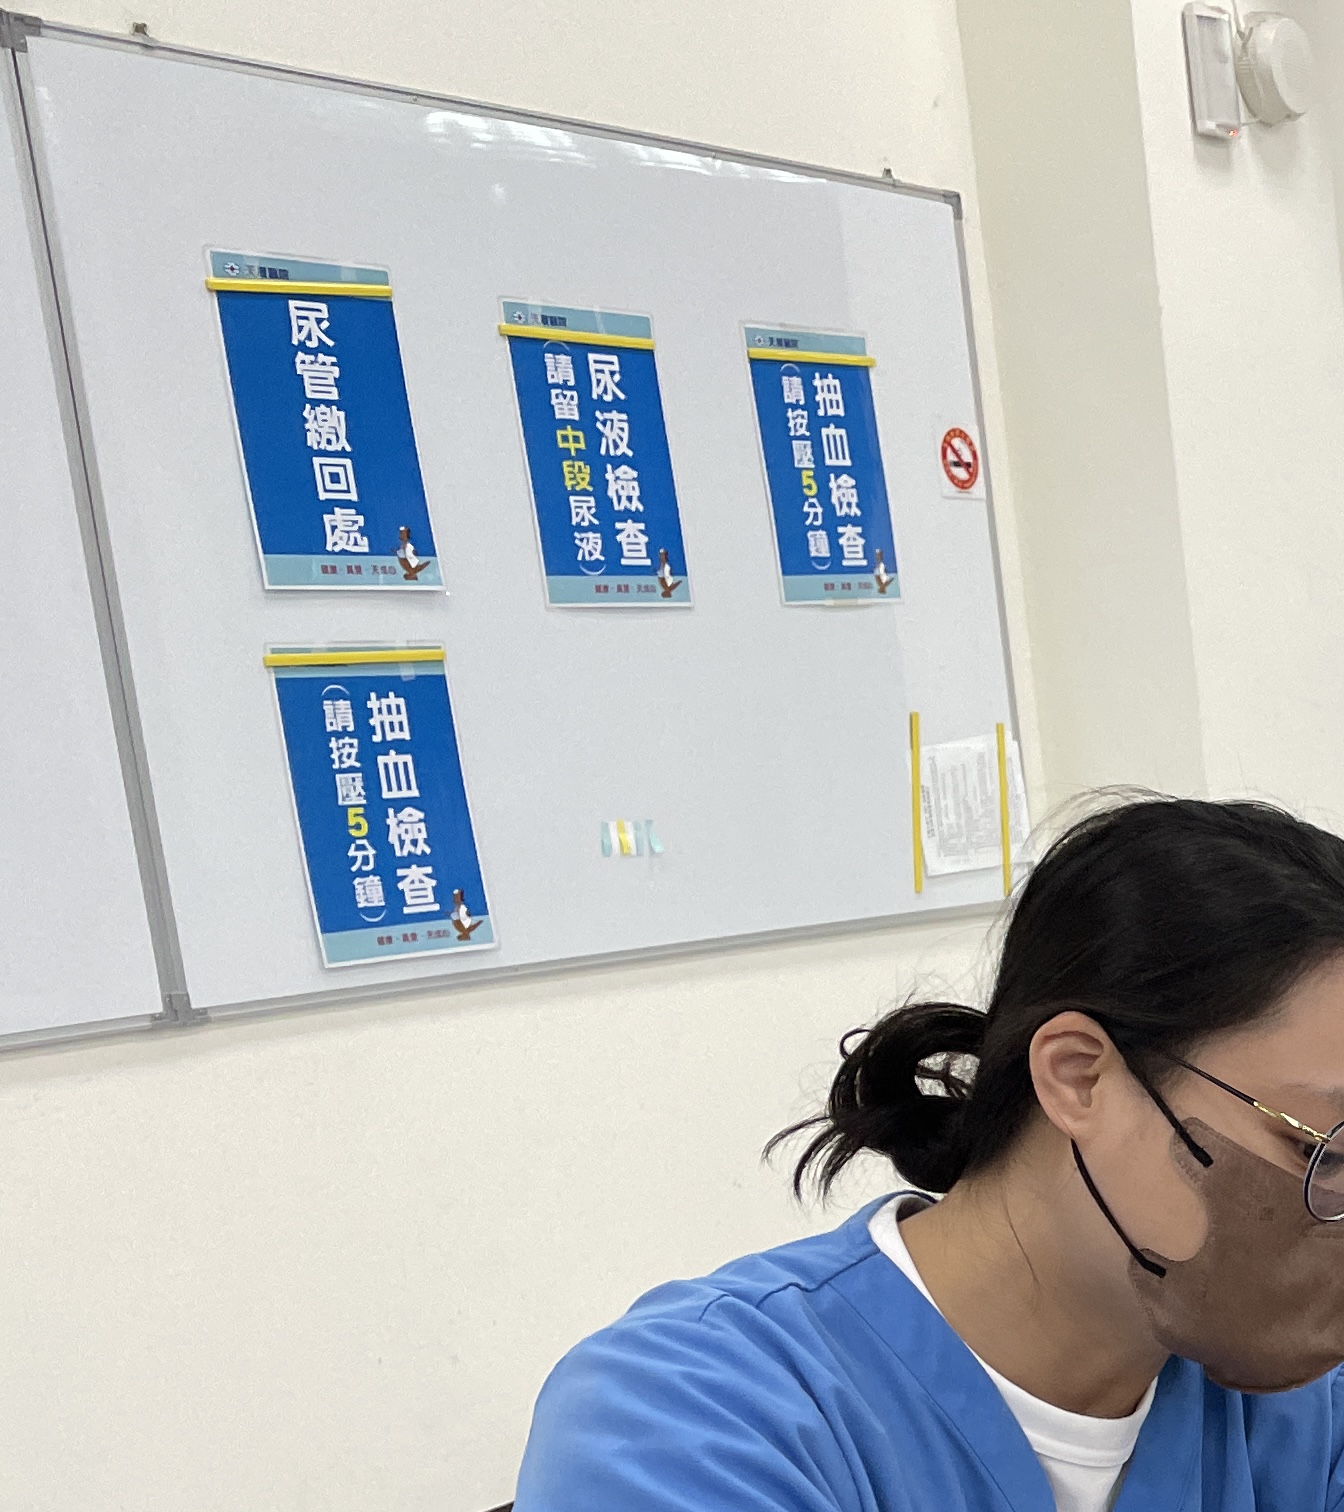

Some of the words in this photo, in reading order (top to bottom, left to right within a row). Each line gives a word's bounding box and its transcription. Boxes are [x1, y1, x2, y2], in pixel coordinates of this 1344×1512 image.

[287, 298, 370, 554] 尿管繳回處
[586, 352, 652, 567] 尿液檢查
[811, 371, 868, 568] 抽血檢查
[366, 691, 440, 914] 抽血檢查
